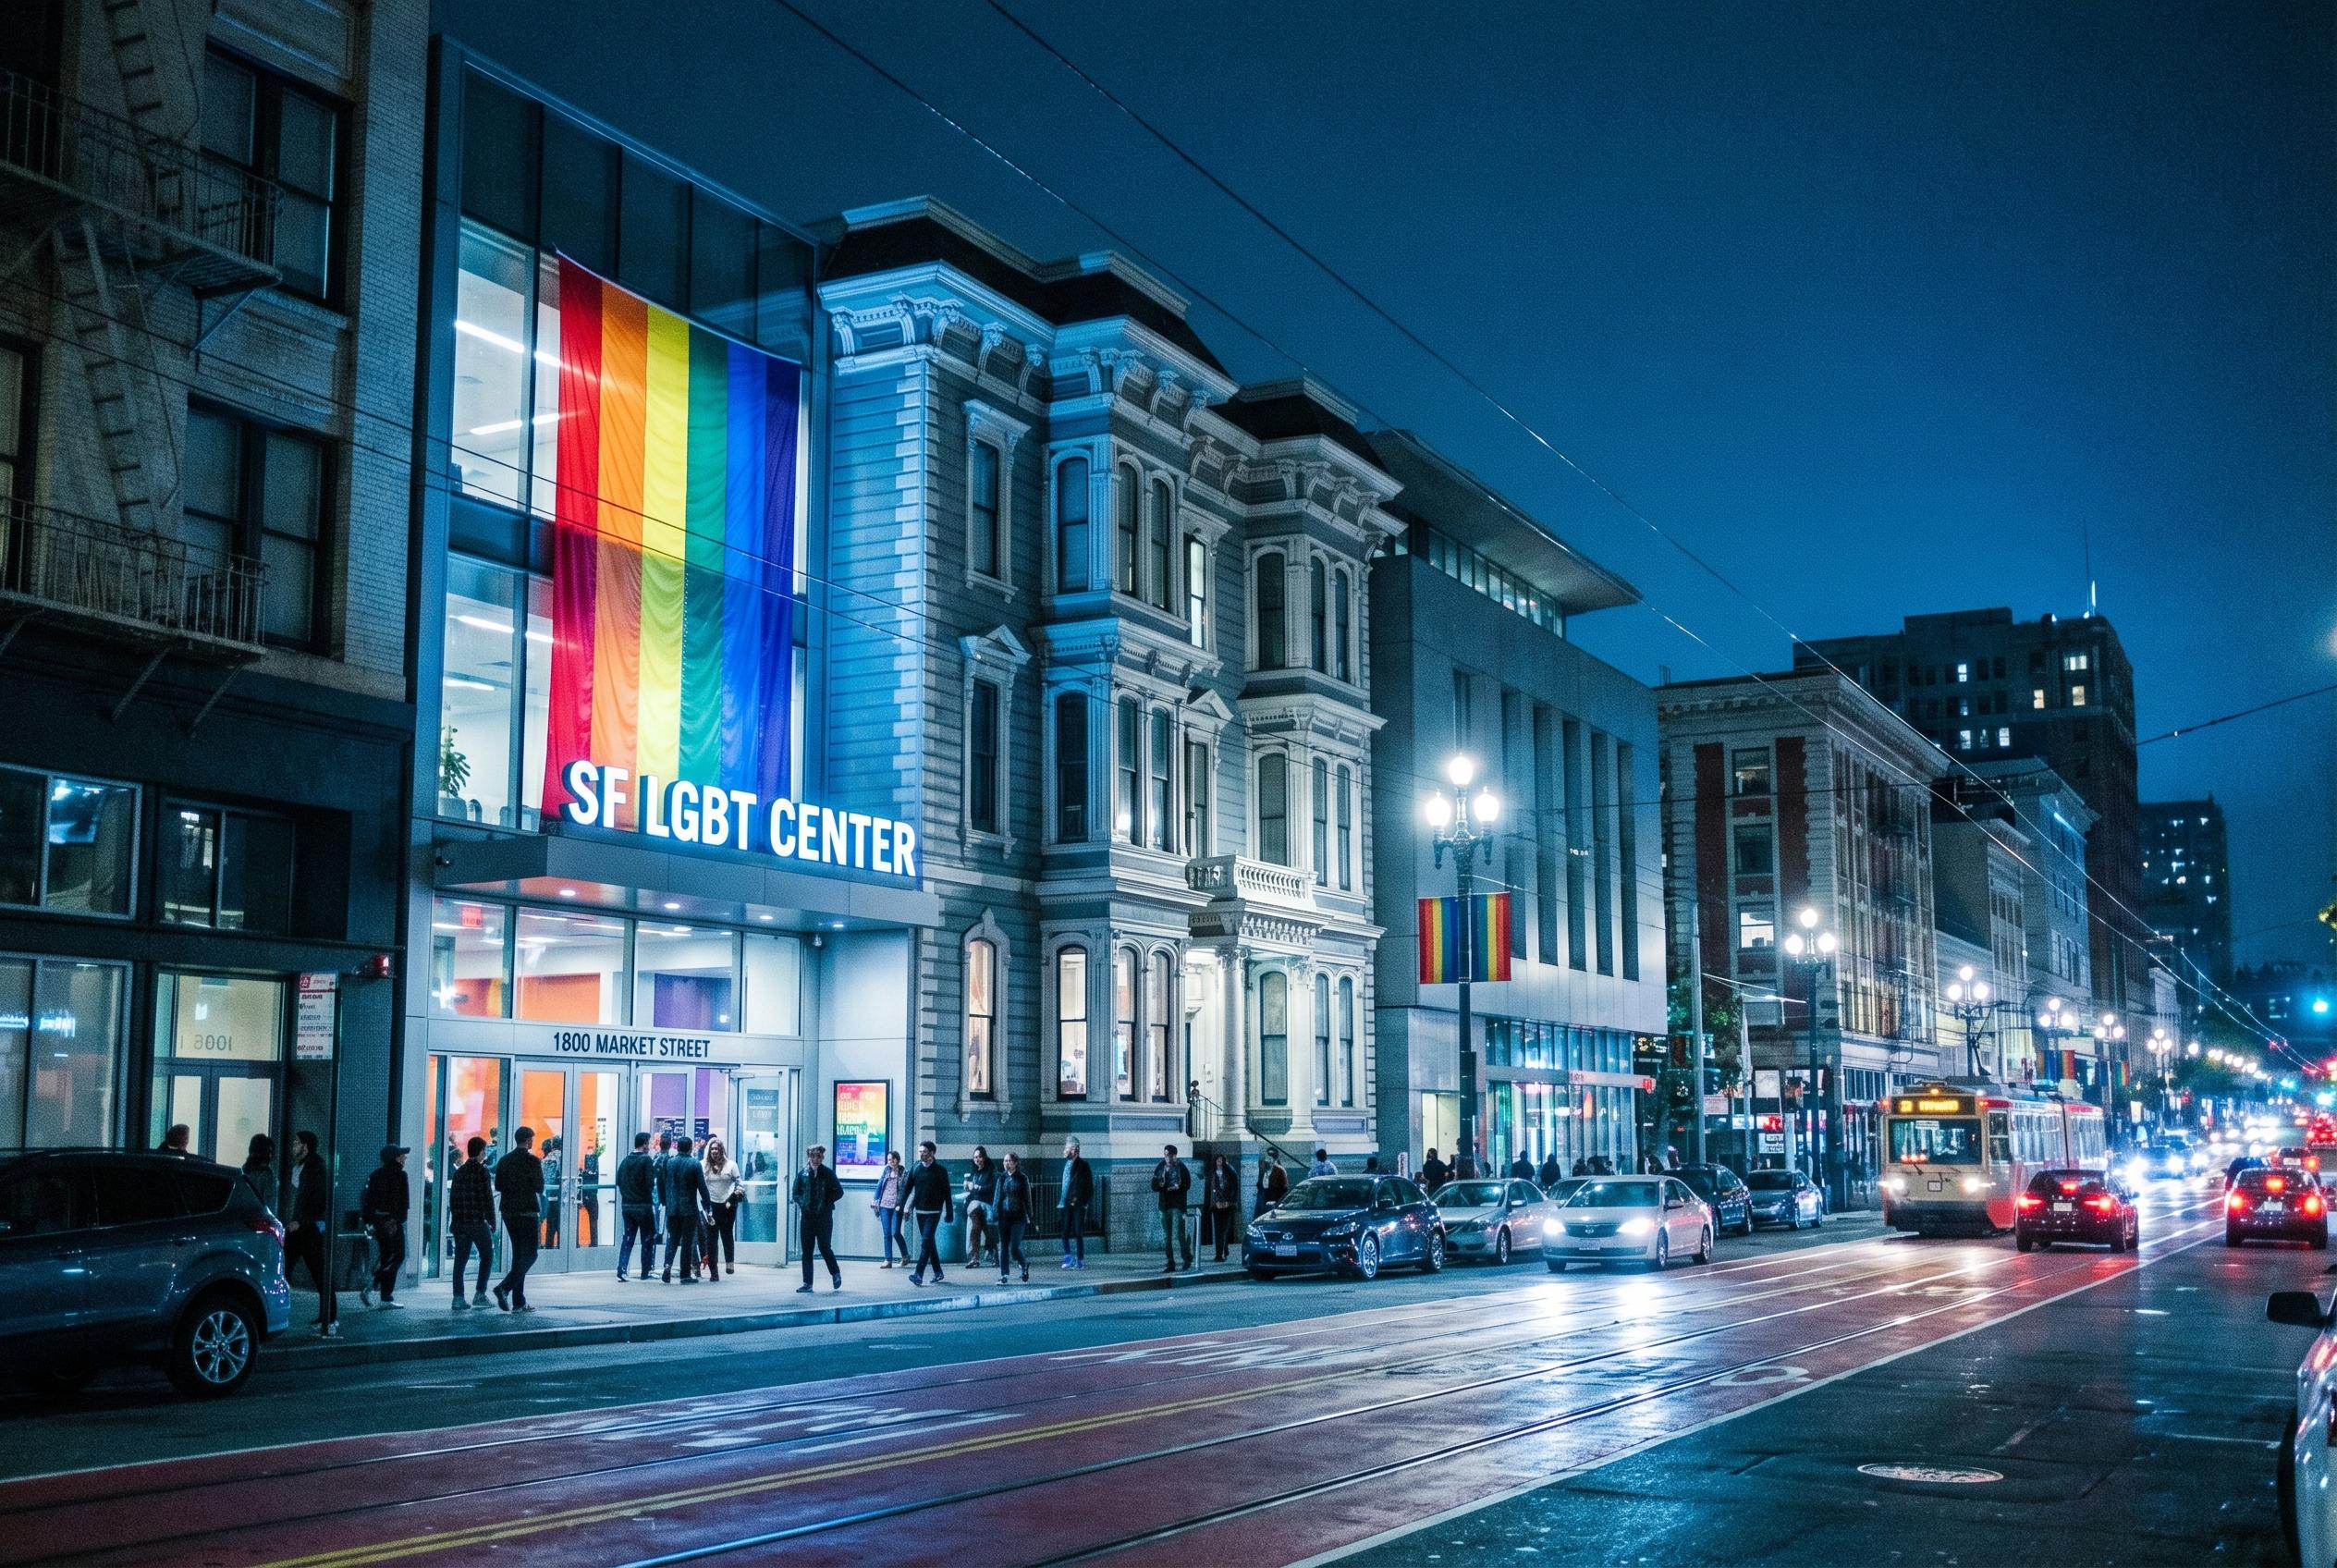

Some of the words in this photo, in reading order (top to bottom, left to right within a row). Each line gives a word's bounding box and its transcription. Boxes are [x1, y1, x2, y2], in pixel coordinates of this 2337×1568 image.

[567, 759, 630, 829] SF
[646, 774, 757, 851] LGBT
[769, 797, 916, 876] CENTER
[553, 1031, 592, 1053] 1800
[595, 1034, 656, 1056] MARKET
[659, 1037, 711, 1059] STREET
